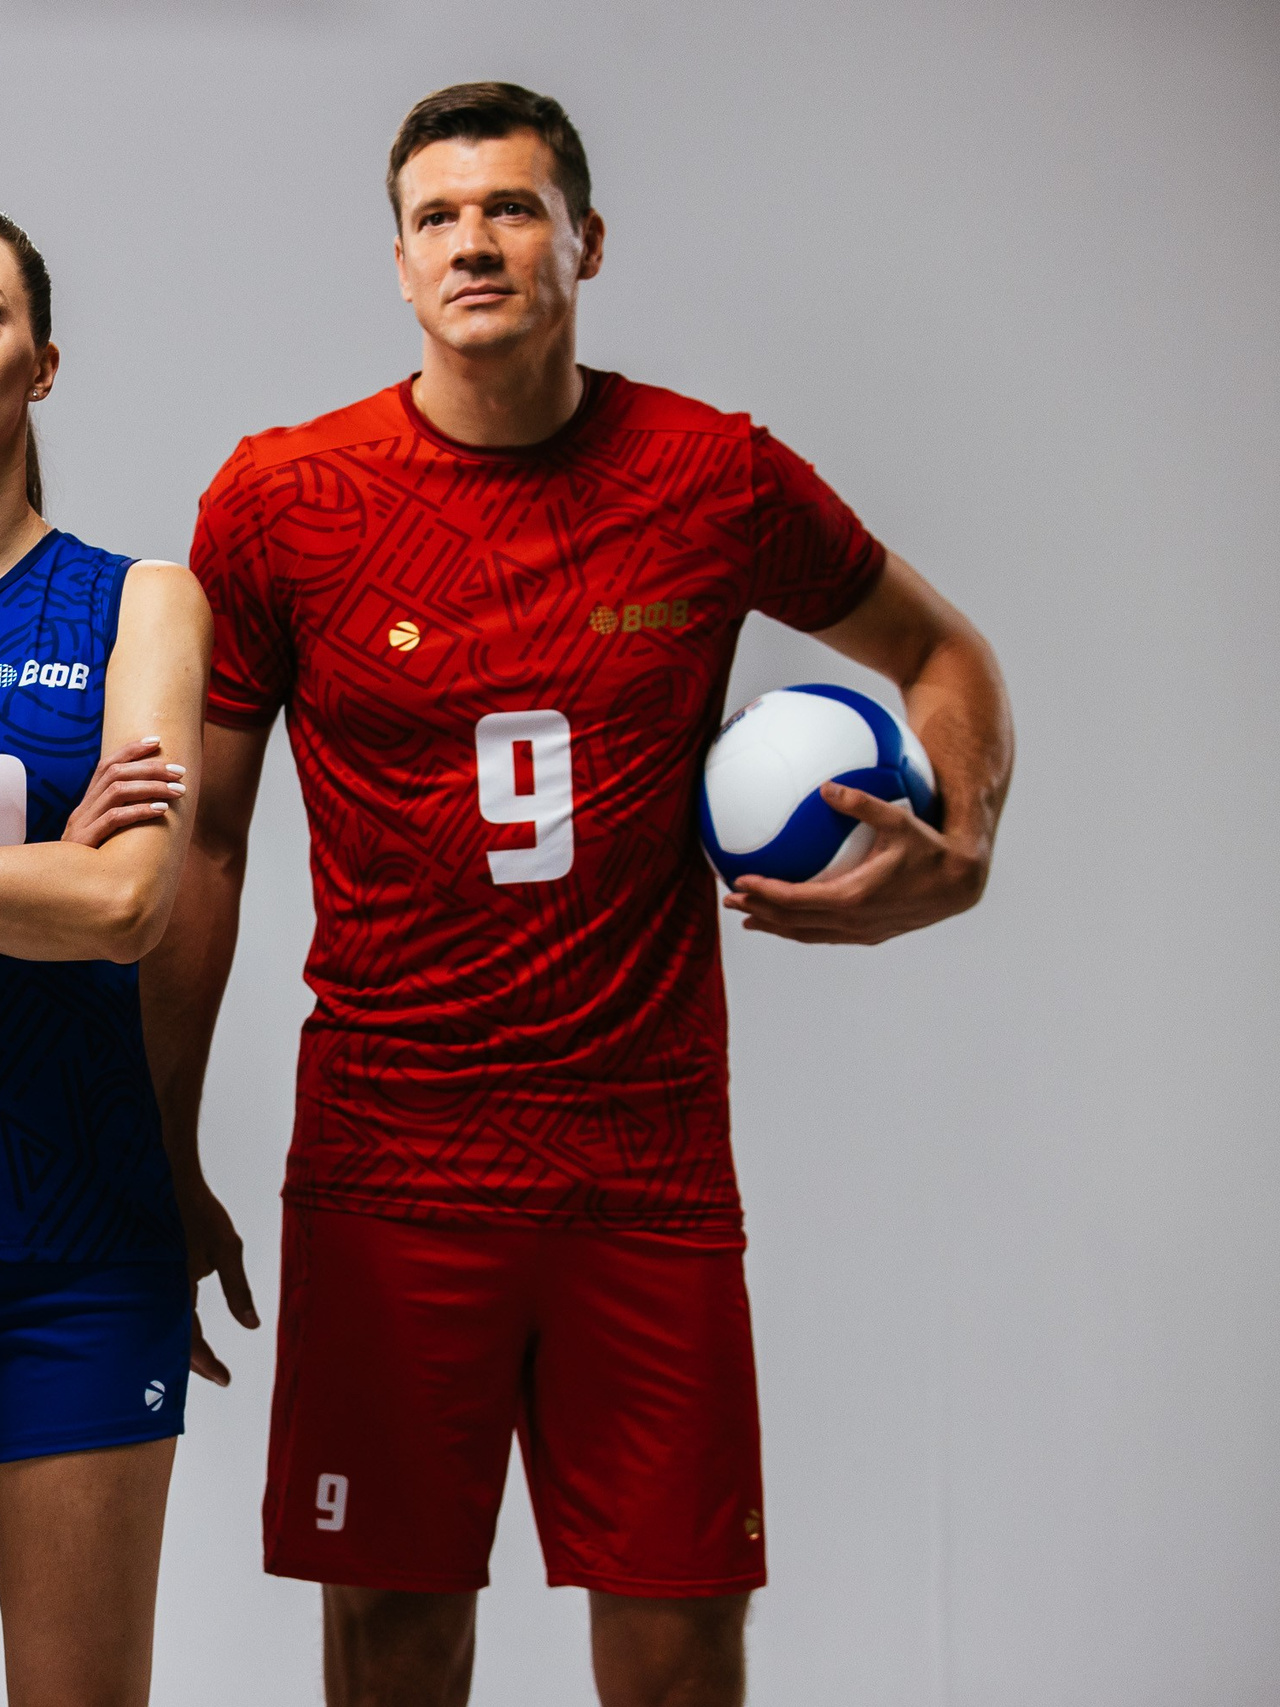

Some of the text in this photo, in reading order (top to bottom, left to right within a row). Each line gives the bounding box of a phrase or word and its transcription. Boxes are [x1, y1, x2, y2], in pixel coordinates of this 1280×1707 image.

[622, 599, 689, 632] ВФВ
[18, 659, 90, 691] ВФВ
[475, 709, 574, 885] 9
[316, 1473, 349, 1531] 9
